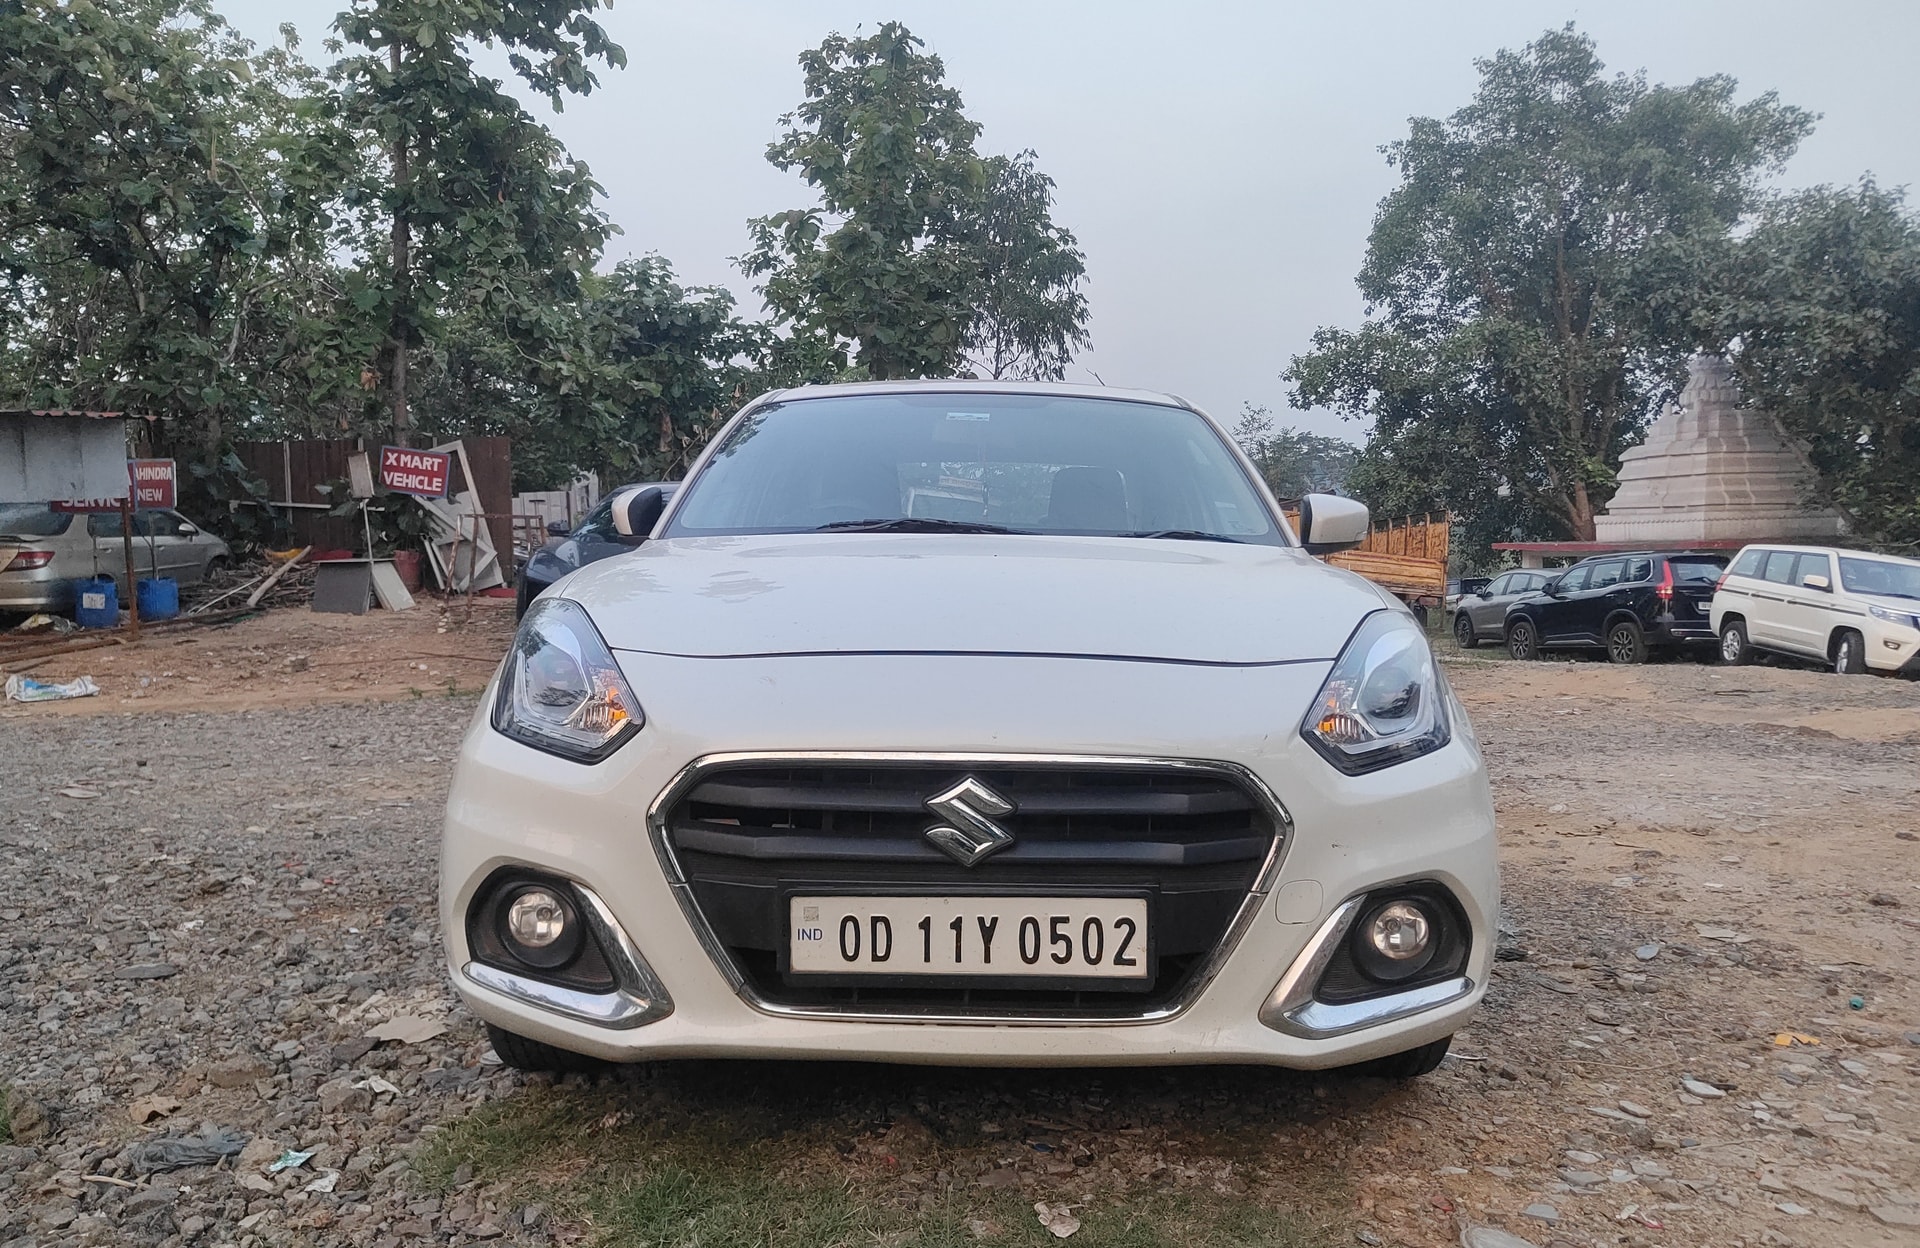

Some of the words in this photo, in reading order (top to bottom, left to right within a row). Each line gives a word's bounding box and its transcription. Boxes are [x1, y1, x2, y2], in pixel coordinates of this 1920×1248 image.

[385, 452, 399, 466] X
[400, 454, 442, 471] MART
[383, 471, 442, 492] VEHICLE
[137, 488, 162, 502] NEW
[797, 928, 823, 941] IND
[839, 915, 893, 962] OD
[918, 915, 999, 964] 11Y
[1018, 916, 1137, 966] 0502
